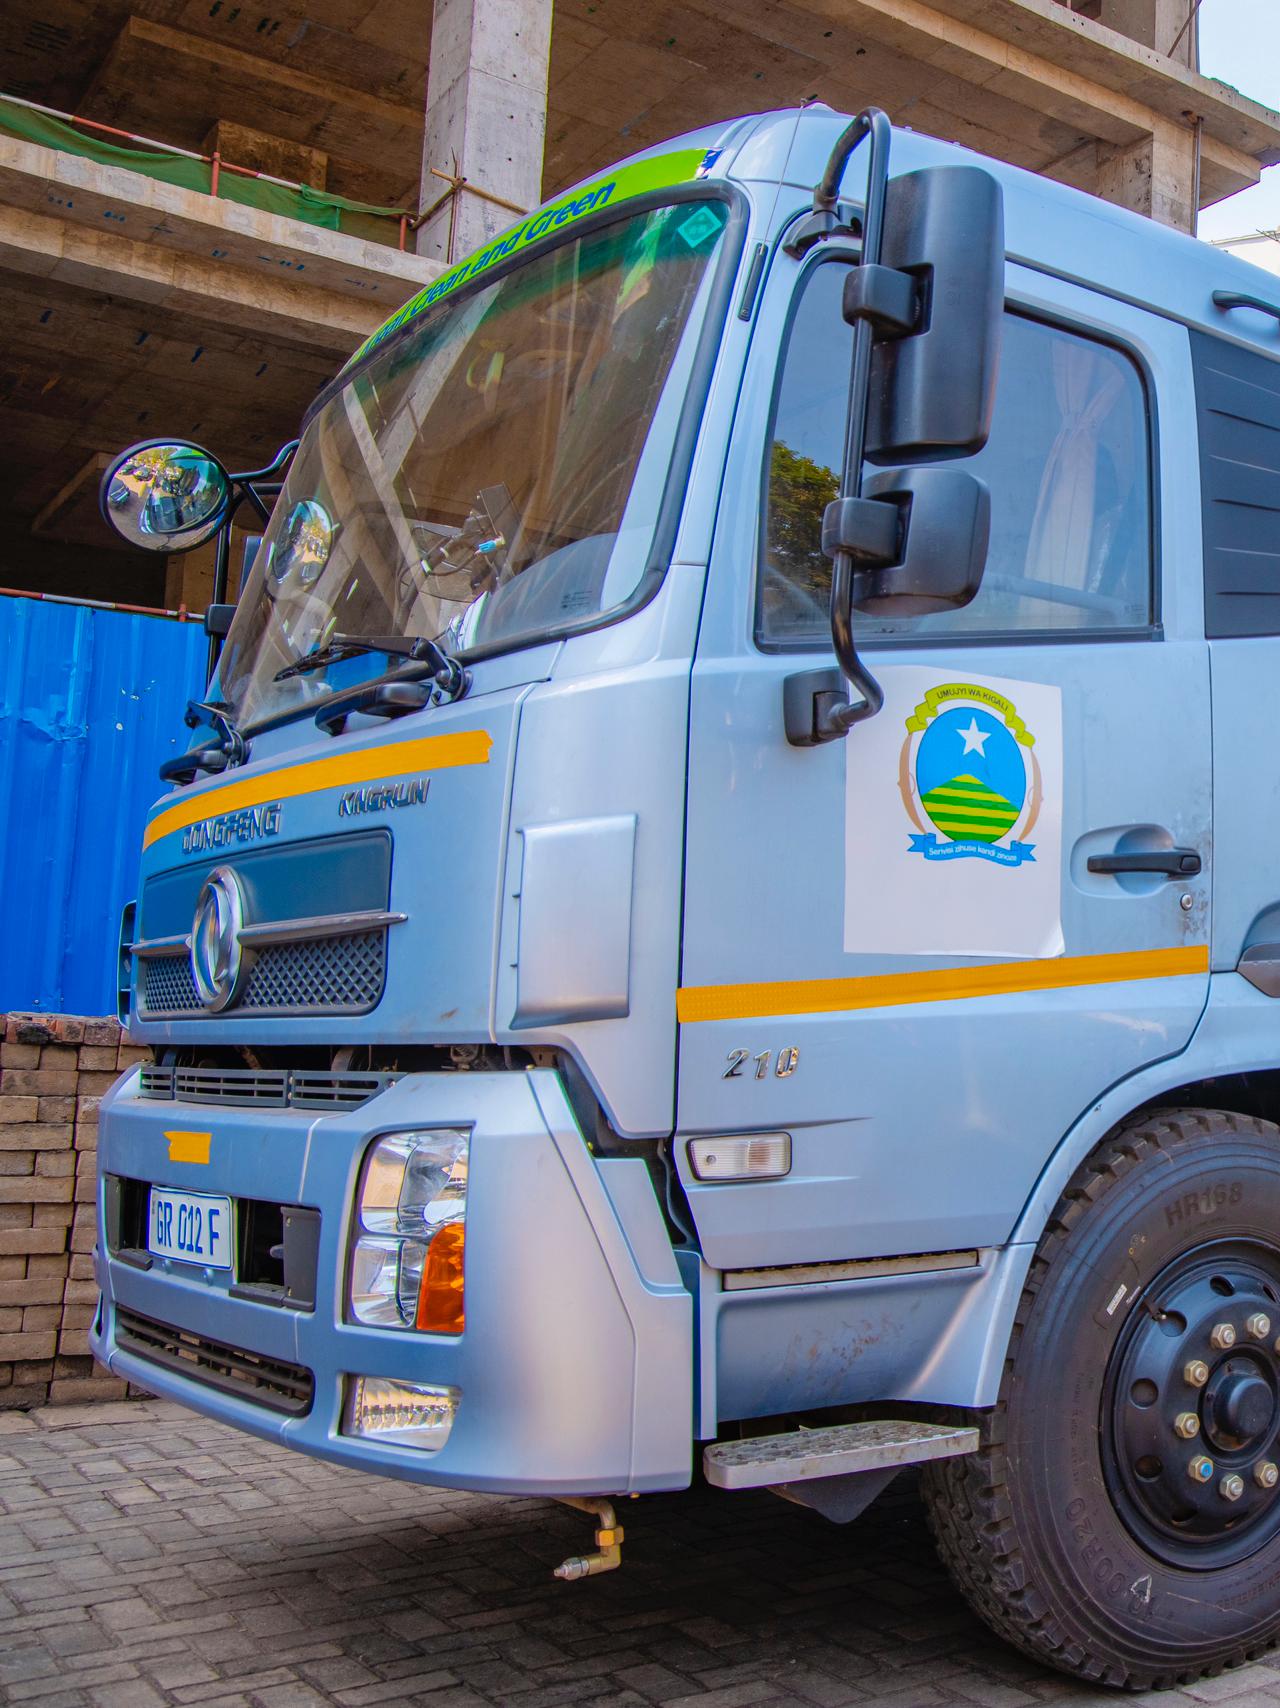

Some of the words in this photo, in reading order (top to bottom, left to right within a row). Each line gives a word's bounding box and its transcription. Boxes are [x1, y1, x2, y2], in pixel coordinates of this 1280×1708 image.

[470, 222, 530, 274] and
[525, 181, 617, 241] Green
[181, 803, 284, 855] DONGFENG
[722, 1046, 800, 1080] 210
[157, 1200, 173, 1249] GR
[177, 1203, 204, 1255] 012
[208, 1208, 220, 1256] F
